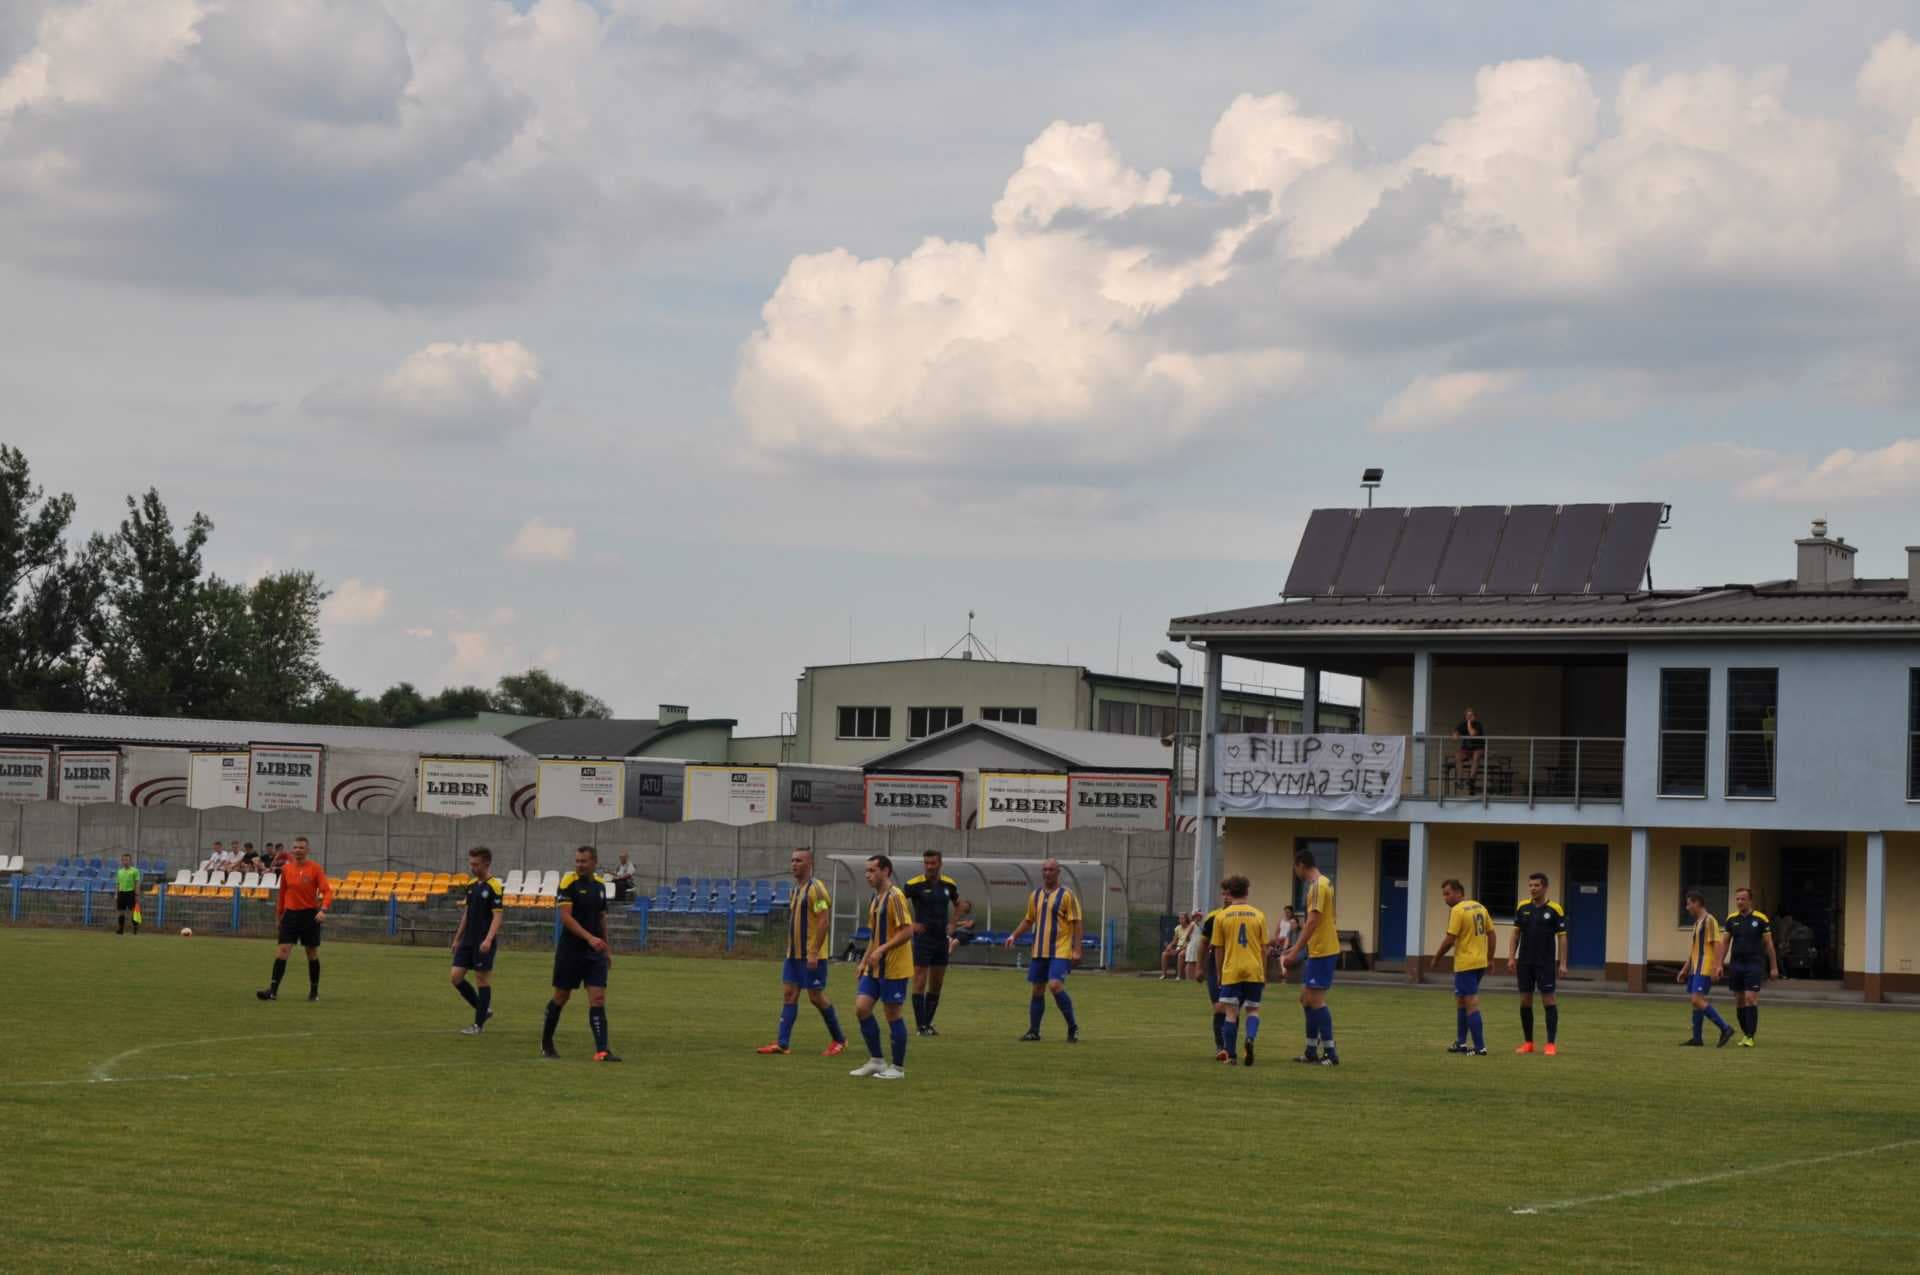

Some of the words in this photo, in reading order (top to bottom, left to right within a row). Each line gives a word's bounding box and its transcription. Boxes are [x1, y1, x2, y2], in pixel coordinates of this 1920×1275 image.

[1249, 737, 1322, 764] FILIP
[64, 767, 111, 780] LIBER
[256, 762, 312, 777] LIBER
[642, 778, 661, 794] ATU
[733, 774, 746, 782] ATU
[427, 781, 488, 797] LIBER
[792, 783, 810, 799] ATU
[875, 792, 947, 808] LIBER
[990, 797, 1066, 813] LIBER
[1078, 792, 1157, 808] LIBER
[1472, 912, 1485, 936] 13
[1238, 922, 1248, 948] 4
